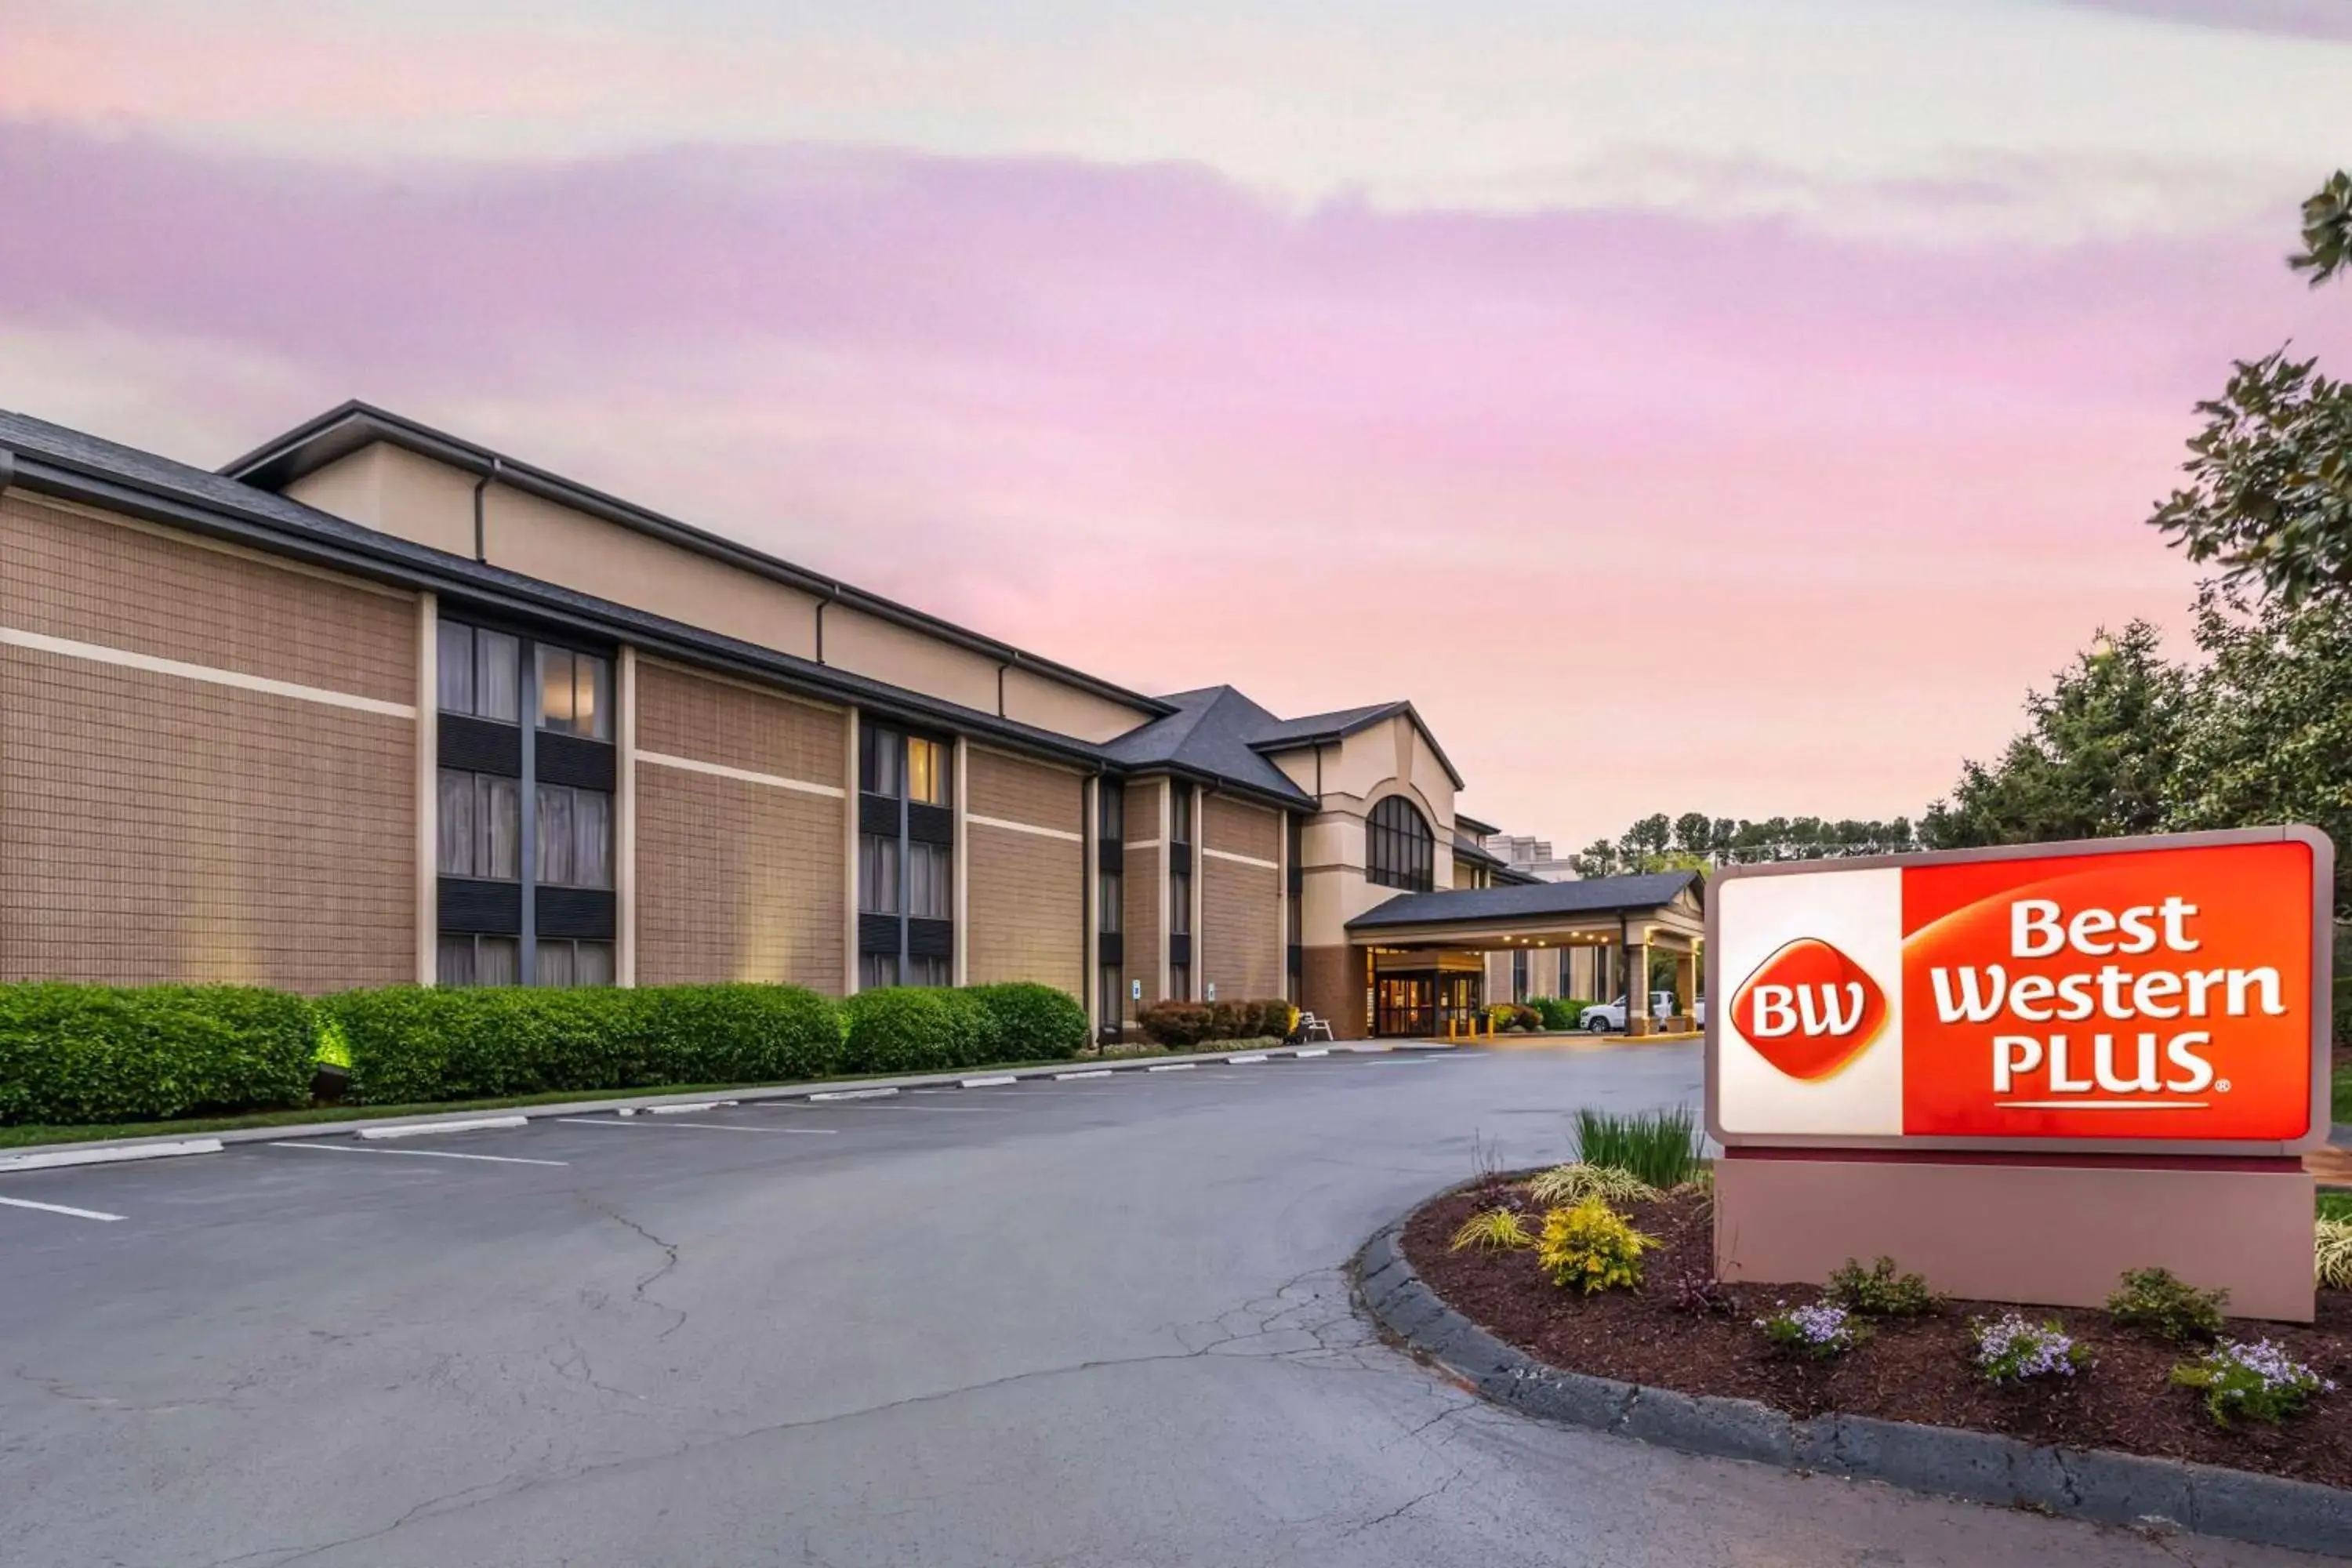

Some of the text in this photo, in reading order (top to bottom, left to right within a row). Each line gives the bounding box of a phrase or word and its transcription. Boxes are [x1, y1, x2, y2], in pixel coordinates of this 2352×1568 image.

[2011, 895, 2200, 957] Best
[1753, 982, 1864, 1036] BW
[1930, 964, 2287, 1023] Western
